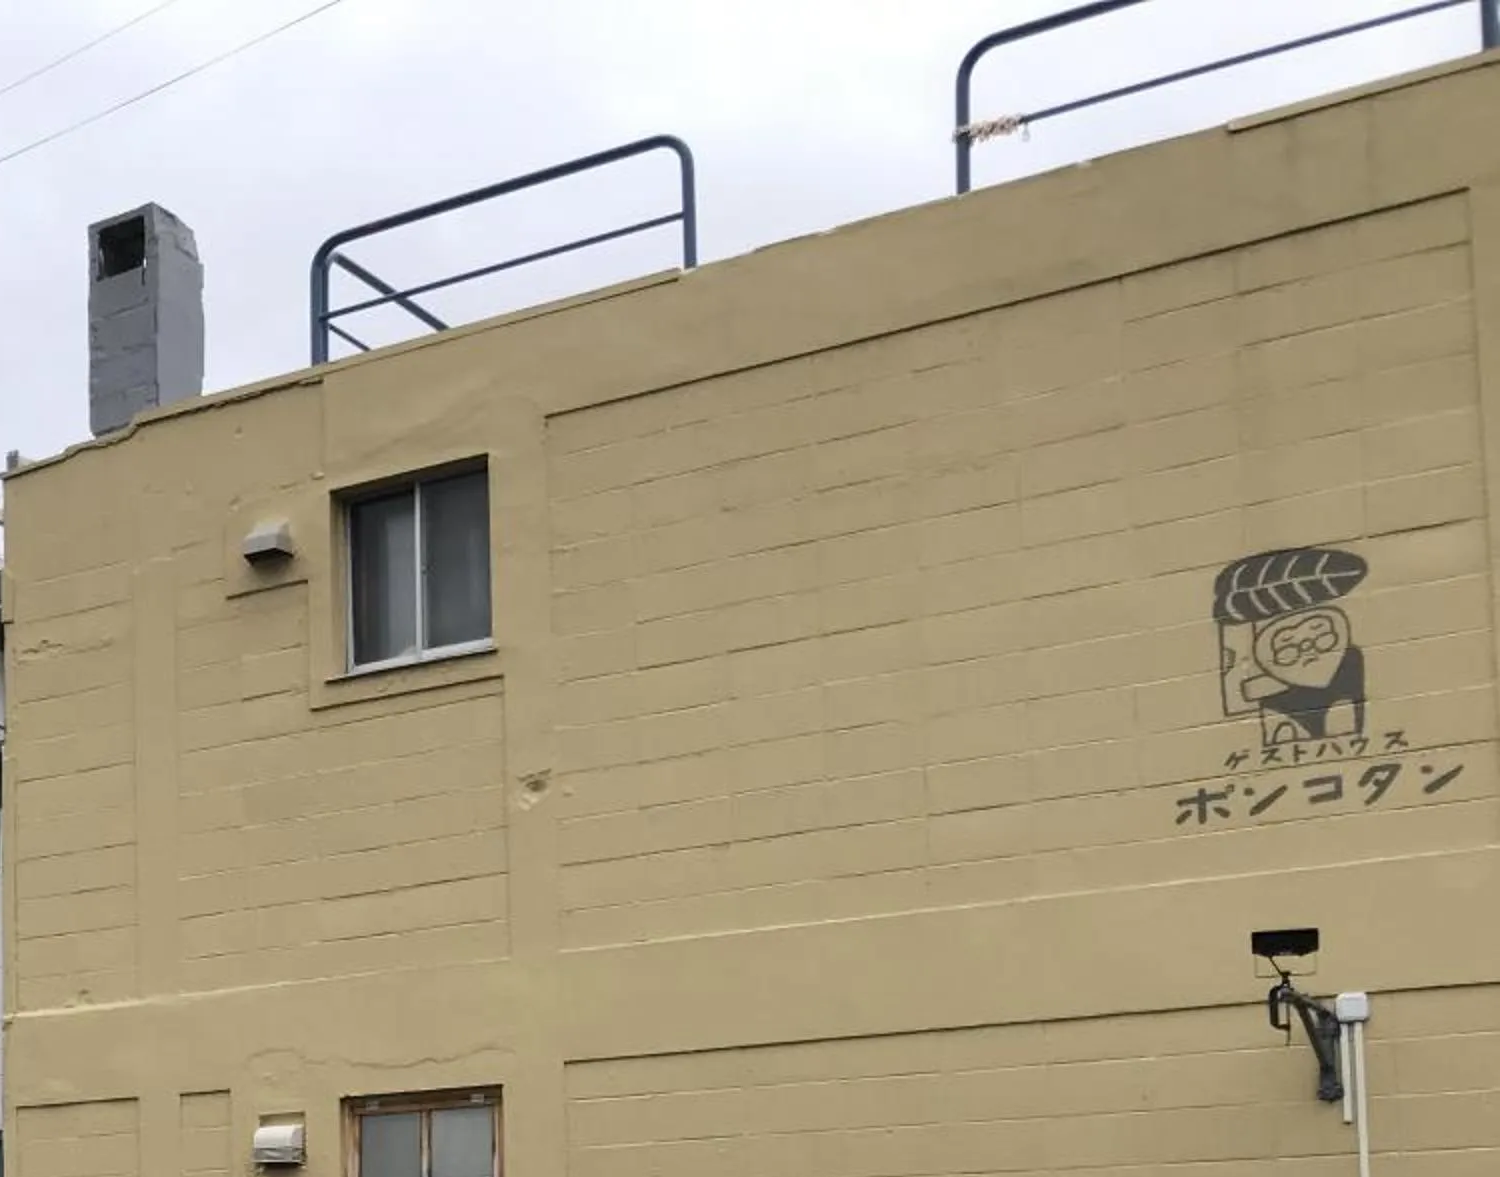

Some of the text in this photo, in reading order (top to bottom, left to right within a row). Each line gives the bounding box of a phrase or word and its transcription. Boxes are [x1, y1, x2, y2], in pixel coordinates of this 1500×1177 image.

[1224, 731, 1408, 769] ゲストハウス
